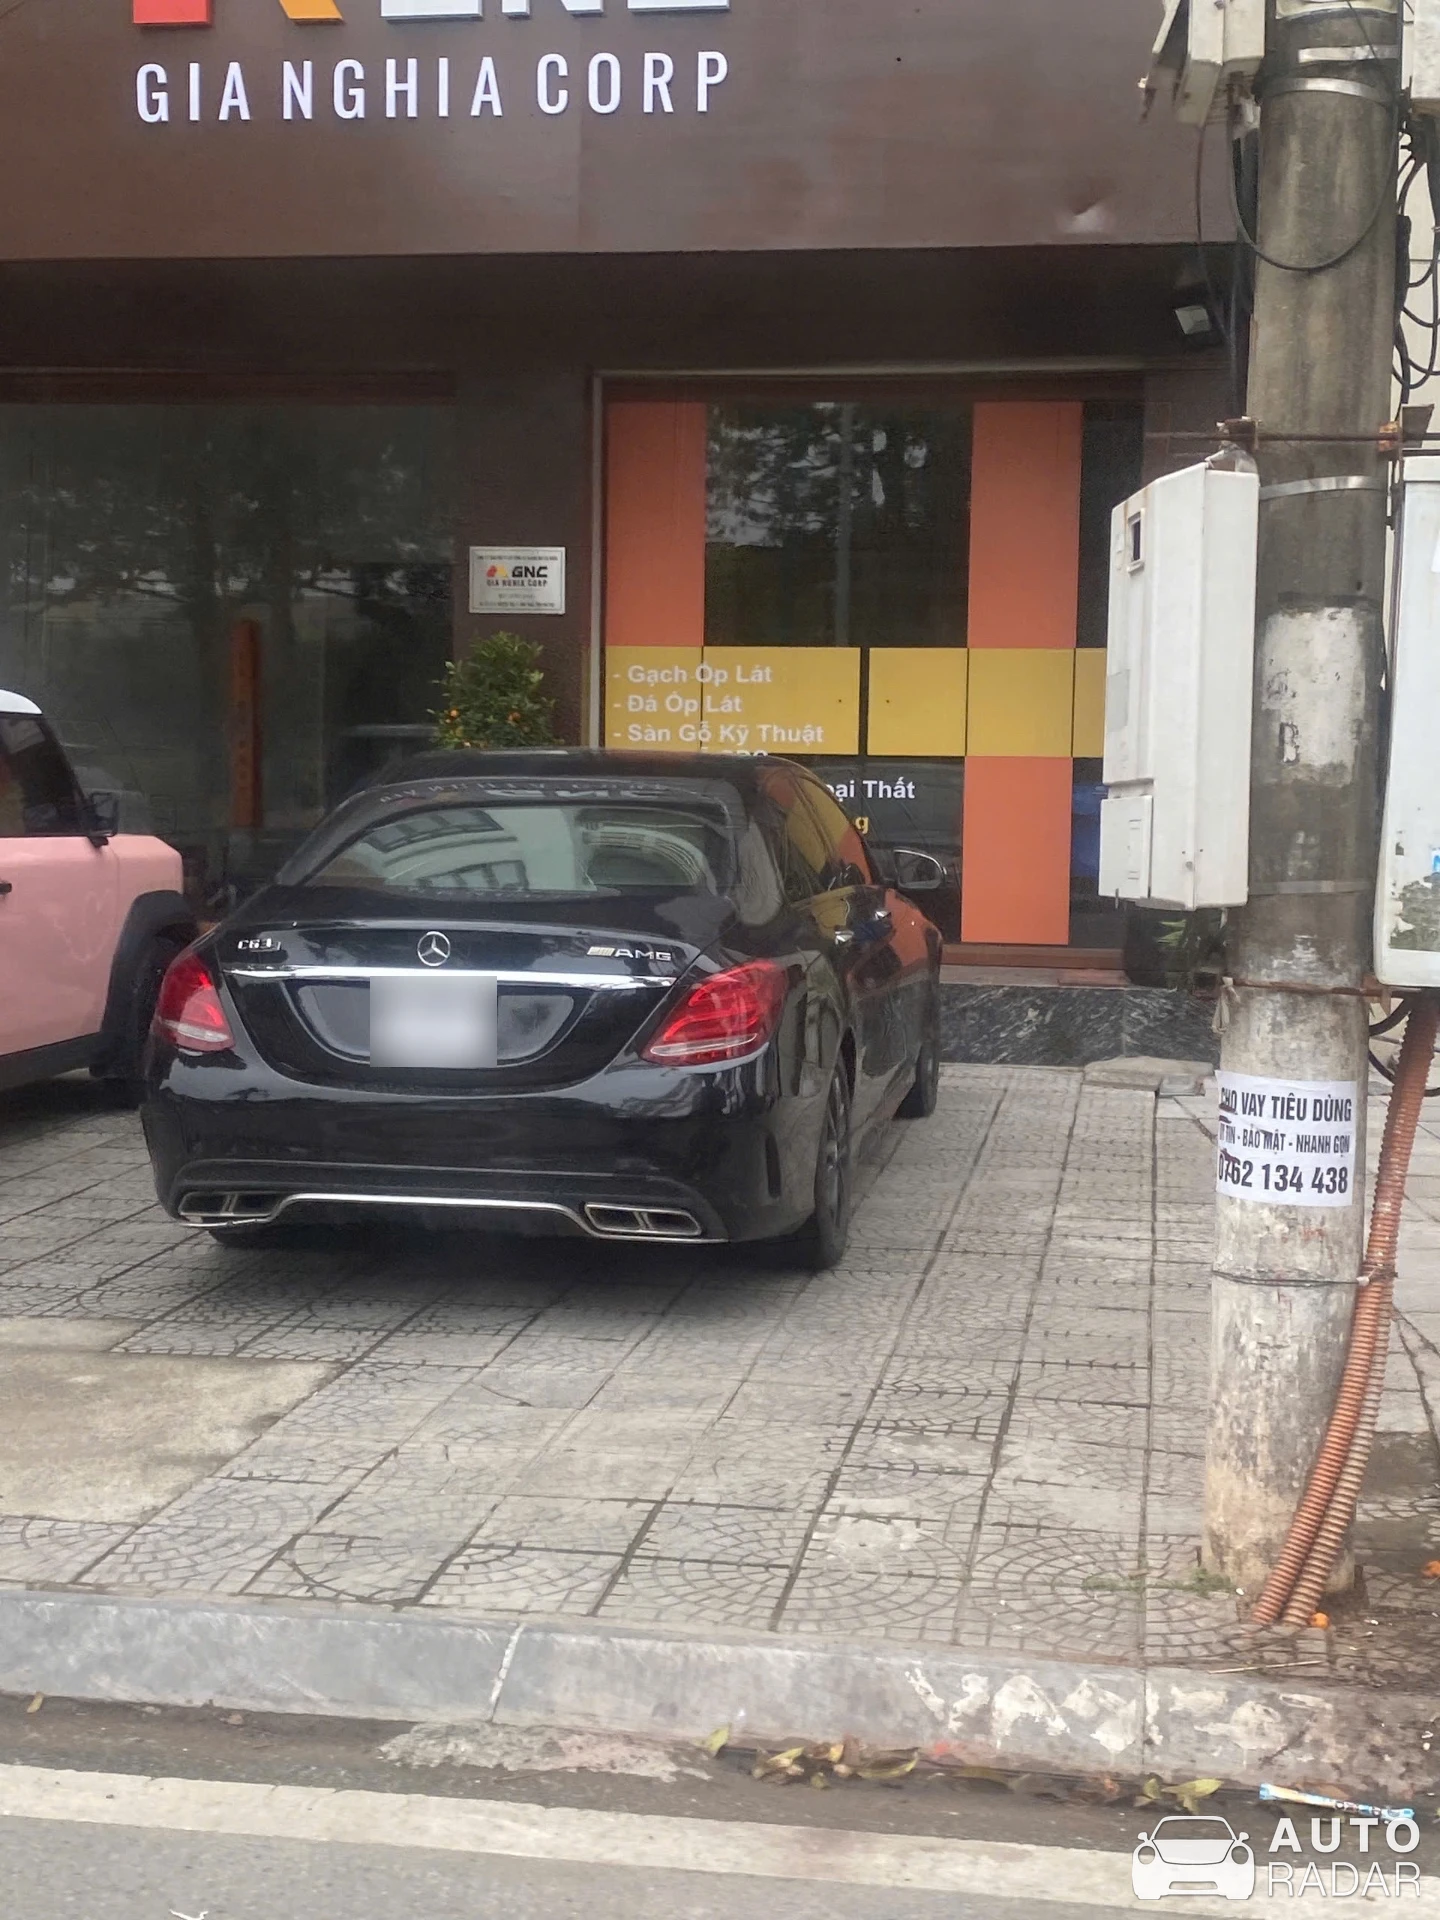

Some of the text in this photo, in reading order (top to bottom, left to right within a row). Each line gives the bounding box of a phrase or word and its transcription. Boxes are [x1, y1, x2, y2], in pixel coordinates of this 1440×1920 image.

[136, 50, 729, 123] GIA NGHIA CORP
[512, 566, 548, 578] GNC
[628, 665, 687, 687] Gạch
[736, 664, 773, 683] Lát
[627, 694, 657, 713] Đá
[705, 694, 743, 713] Lát
[628, 723, 671, 742] Sàn
[862, 776, 916, 799] Thất
[615, 948, 672, 962] AMG
[1241, 1091, 1267, 1117] VAY
[1271, 1092, 1308, 1121] TIÊU
[1312, 1094, 1352, 1122] DÙNG
[1295, 1134, 1332, 1154] NHANH
[1261, 1163, 1304, 1193] 134
[1311, 1166, 1349, 1194] 438
